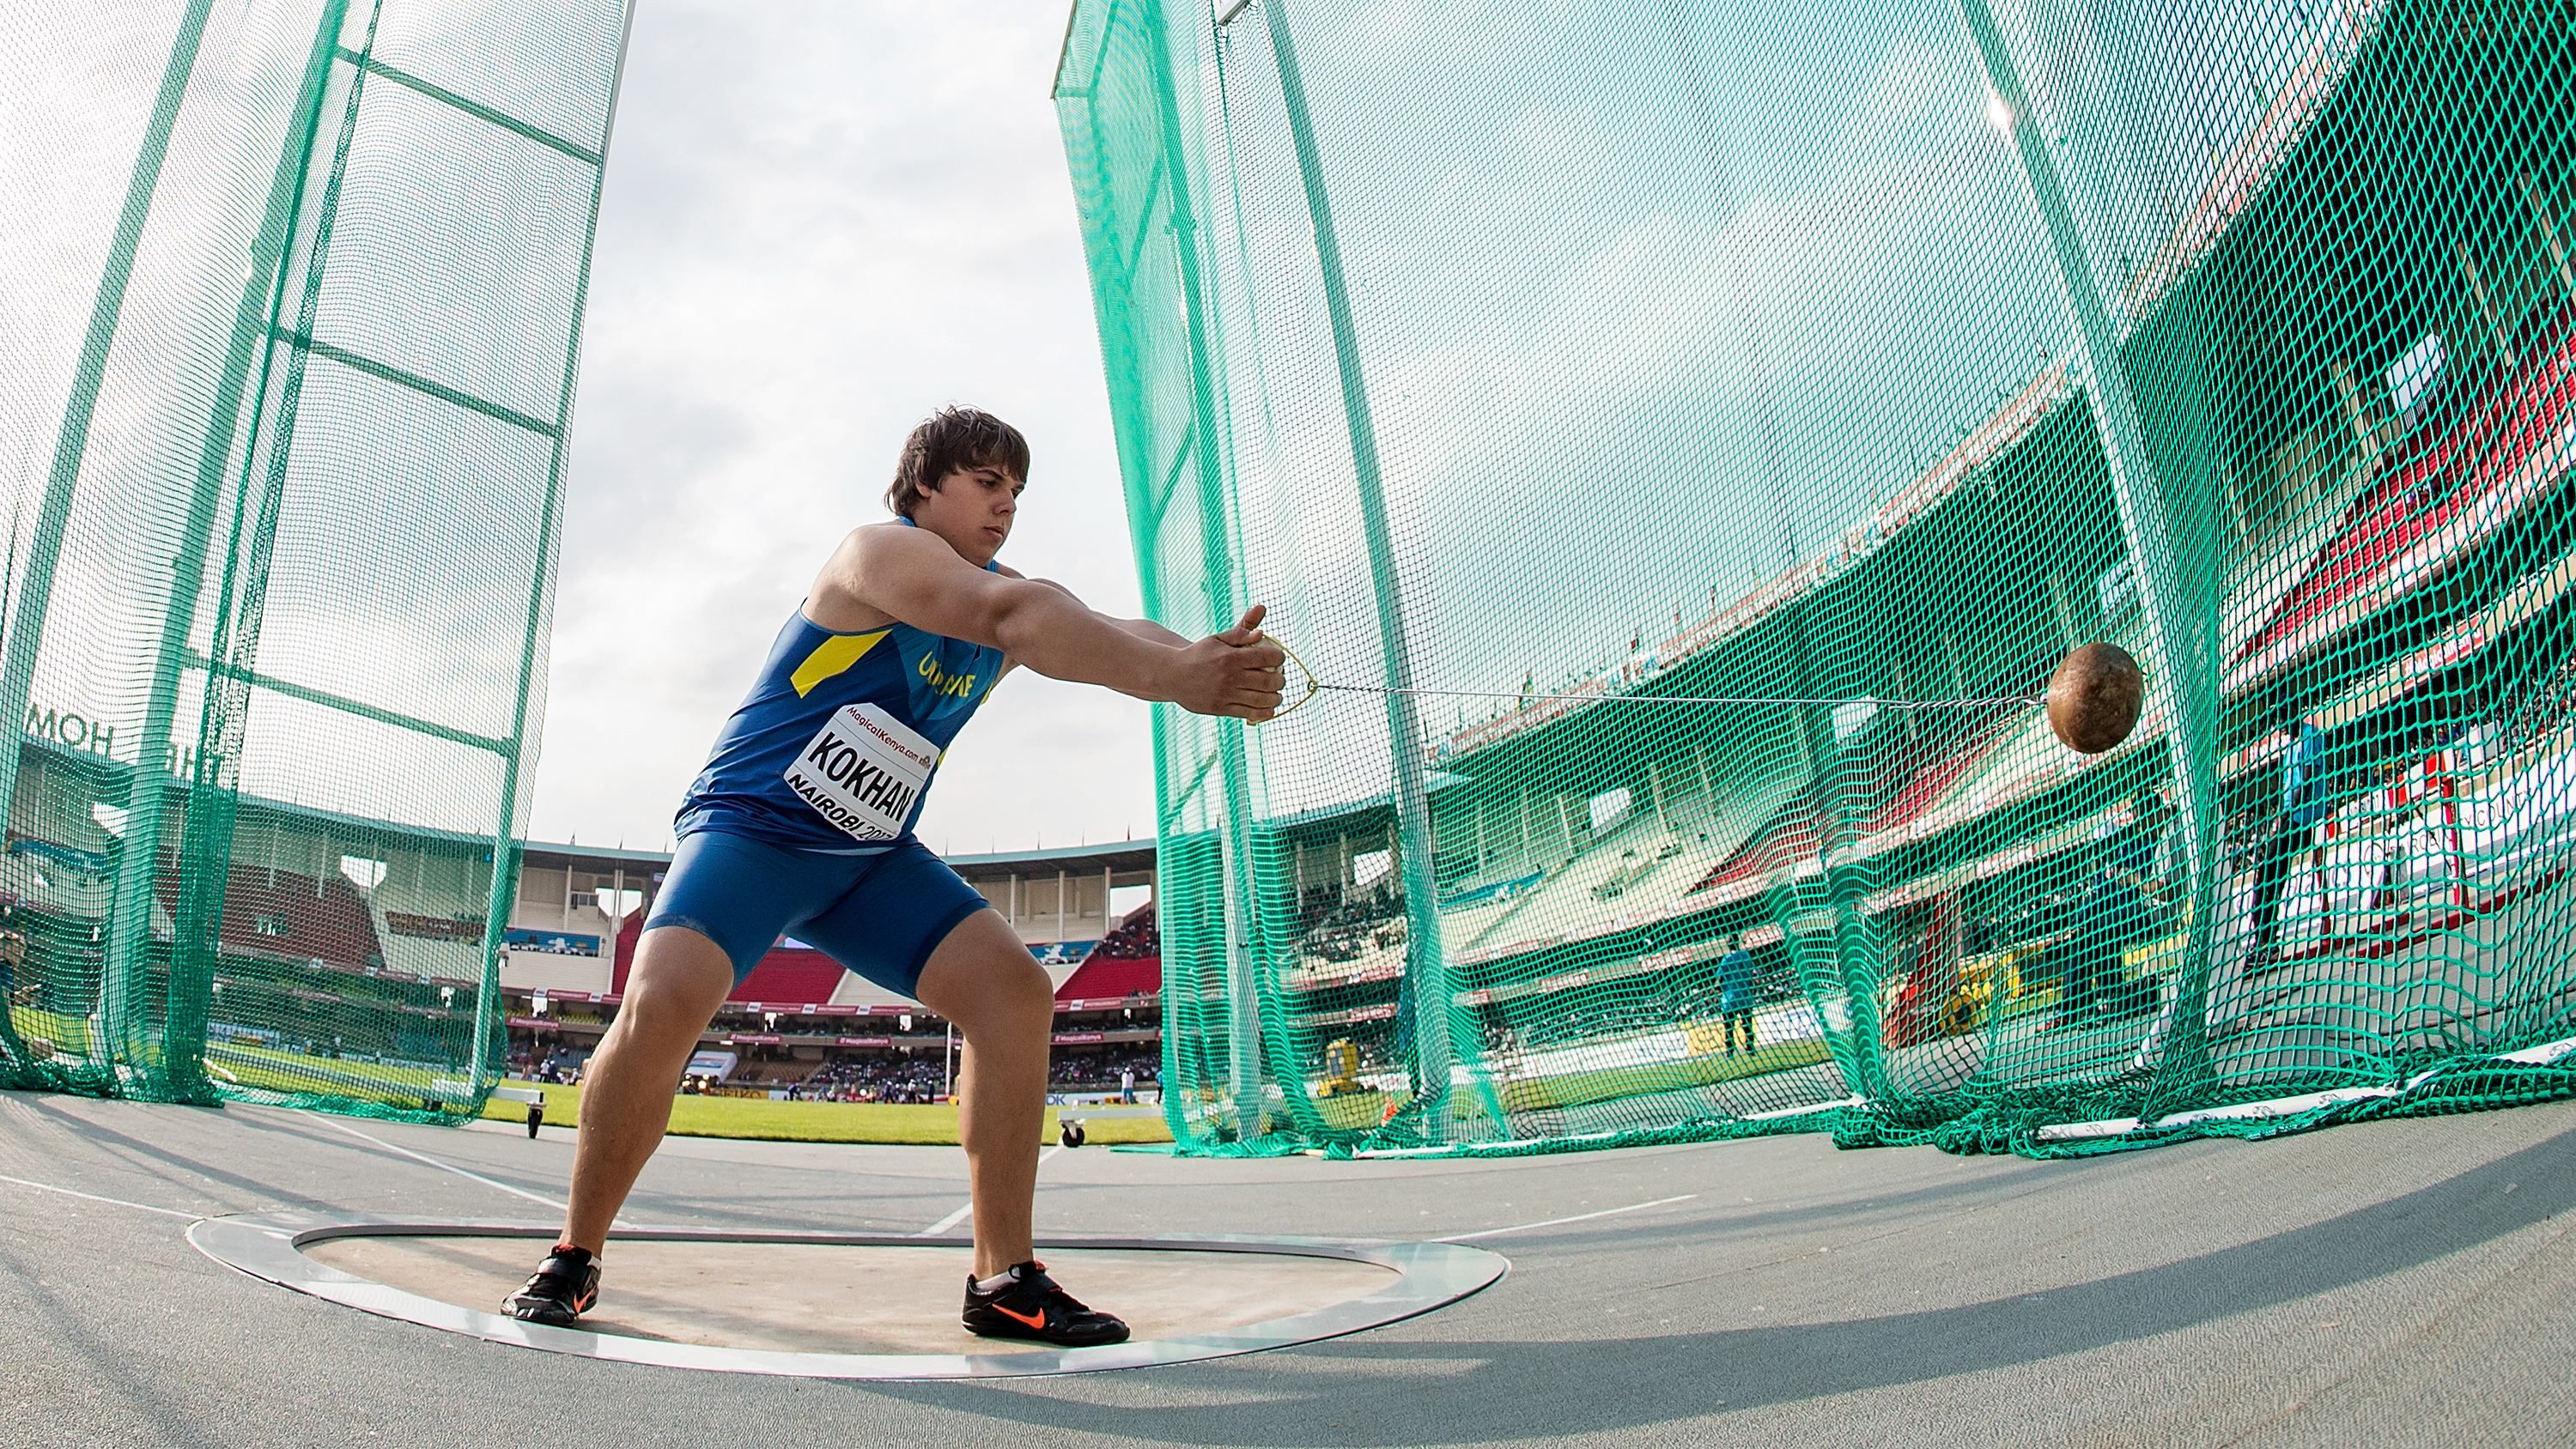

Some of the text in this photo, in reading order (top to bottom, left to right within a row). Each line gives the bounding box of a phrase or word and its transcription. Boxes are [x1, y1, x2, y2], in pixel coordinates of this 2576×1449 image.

[847, 707, 918, 761] MagicalKenya.com
[787, 773, 866, 832] NAIROBI
[807, 731, 914, 822] KOKHAN
[720, 1089, 762, 1099] EIKO
[1046, 1094, 1066, 1106] DK
